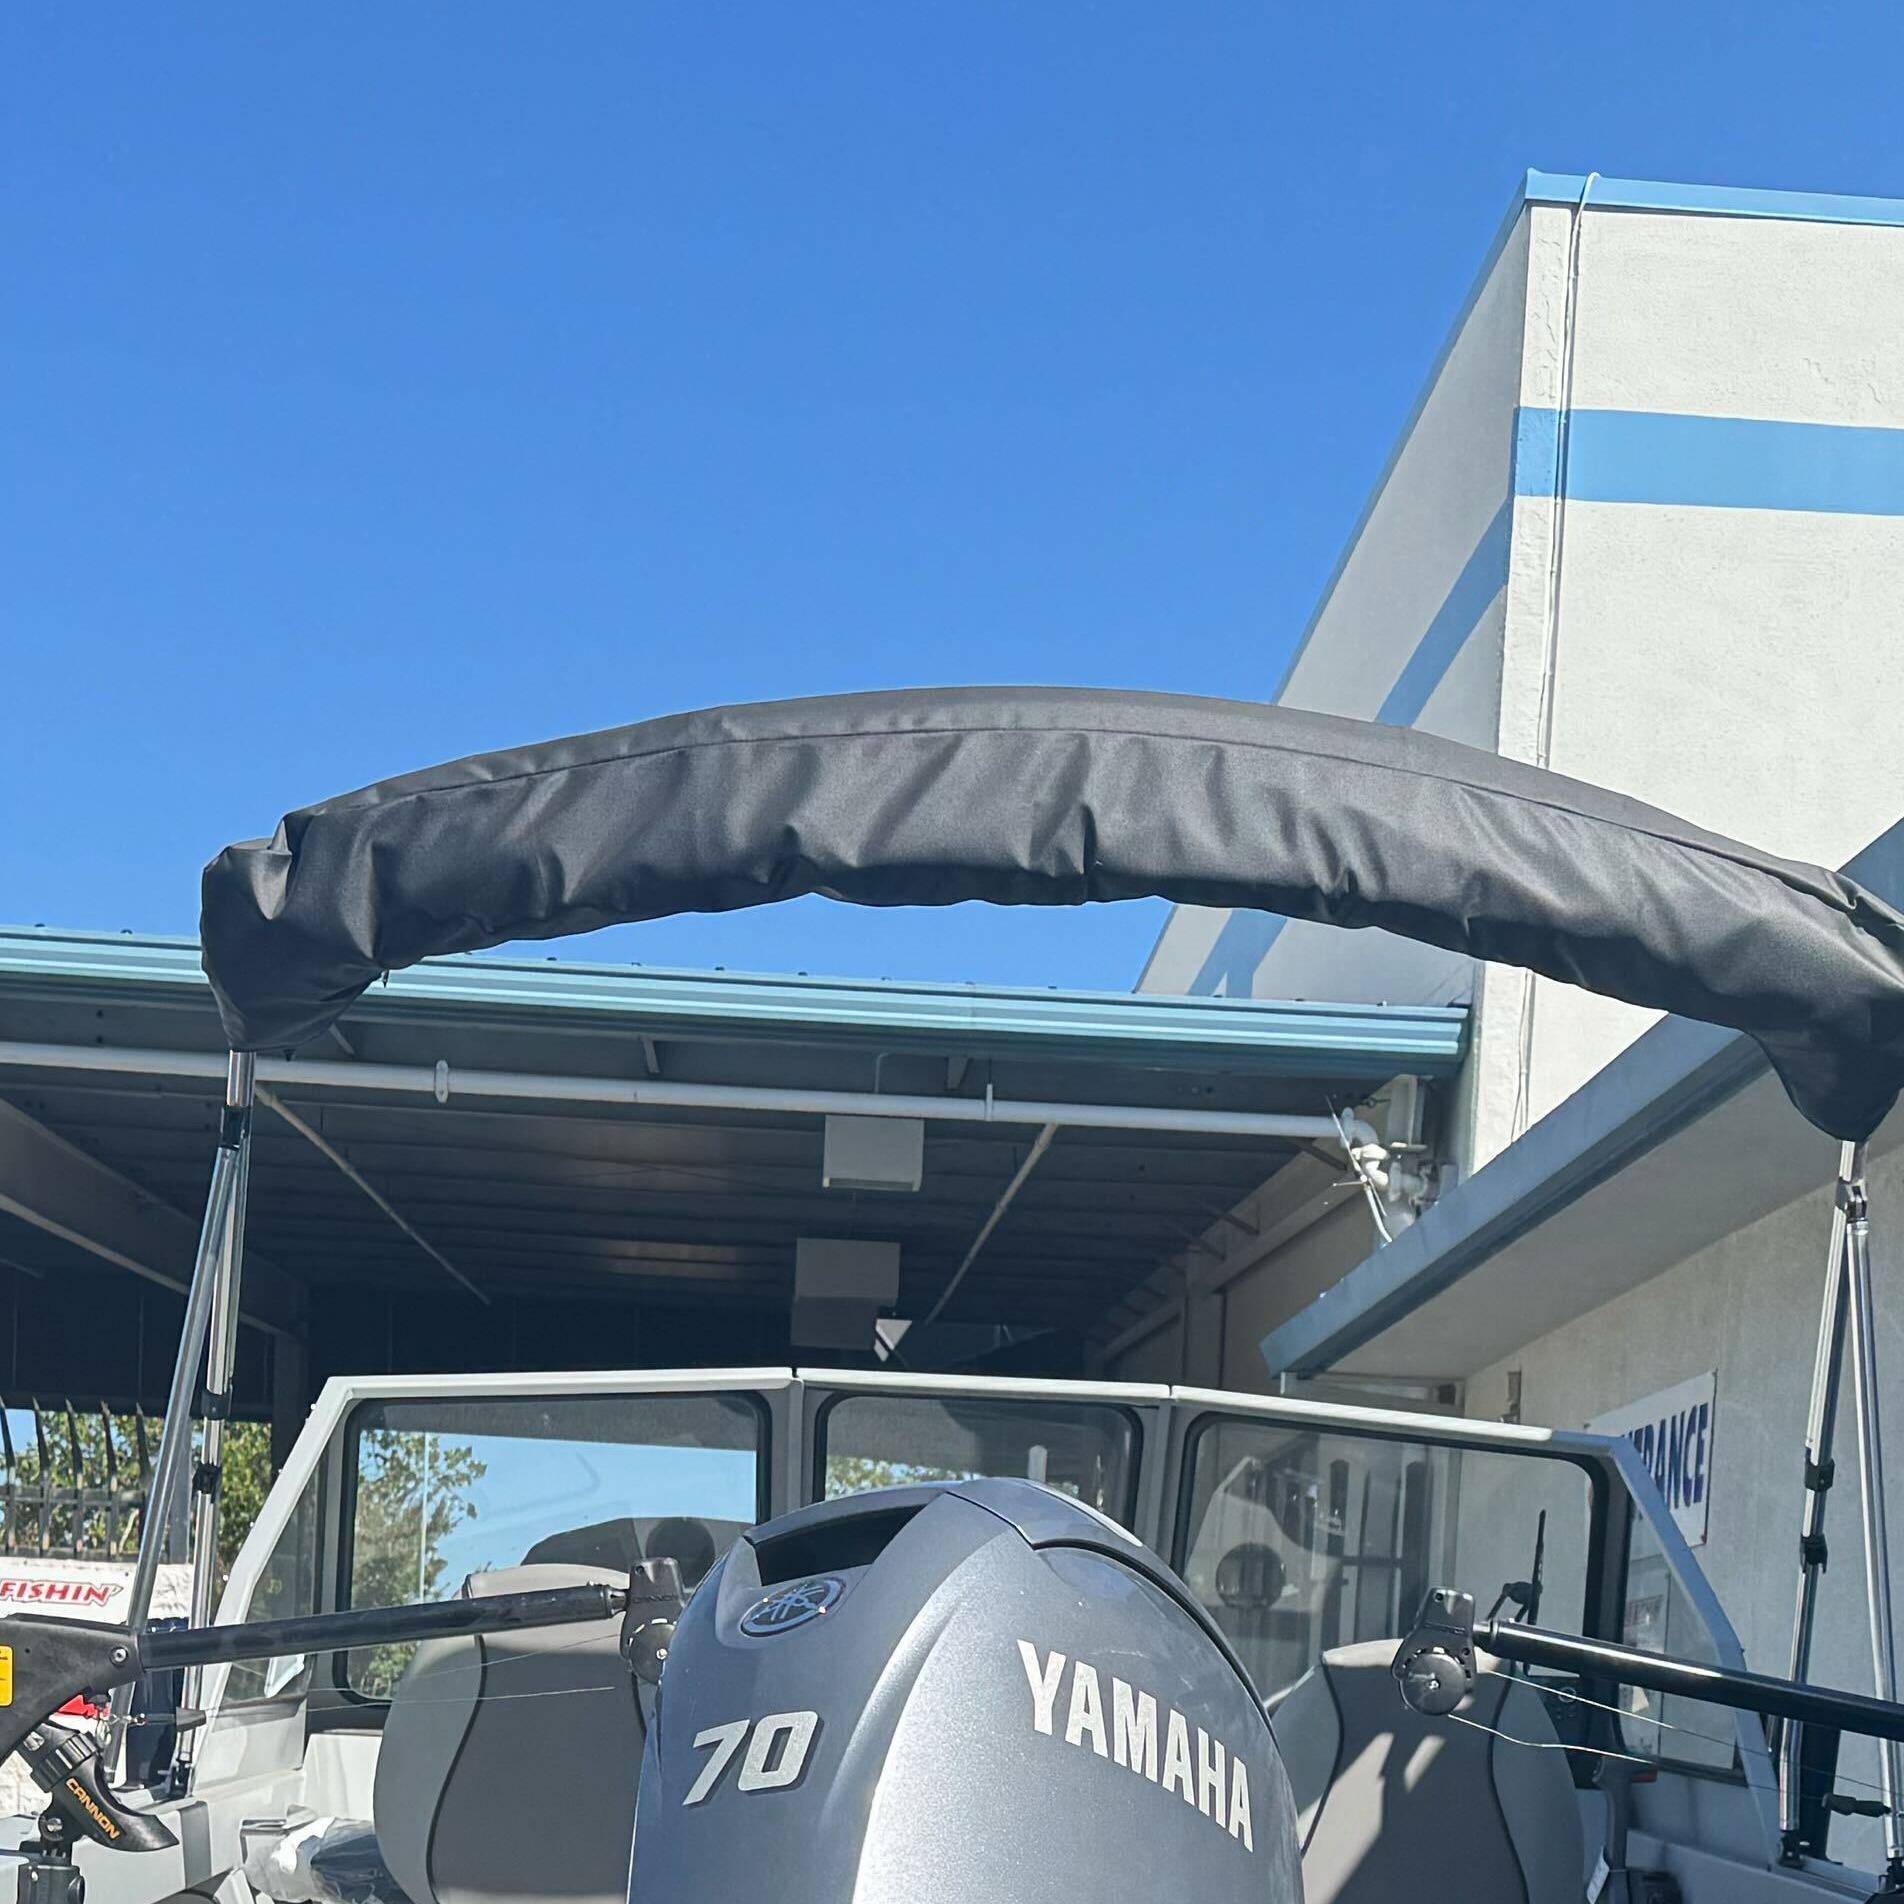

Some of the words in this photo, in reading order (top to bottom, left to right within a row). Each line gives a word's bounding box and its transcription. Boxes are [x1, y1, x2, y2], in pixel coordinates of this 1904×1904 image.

[683, 1711, 820, 1806] 70
[1017, 1639, 1254, 1853] YAMAHA
[66, 1778, 120, 1839] CANNON
